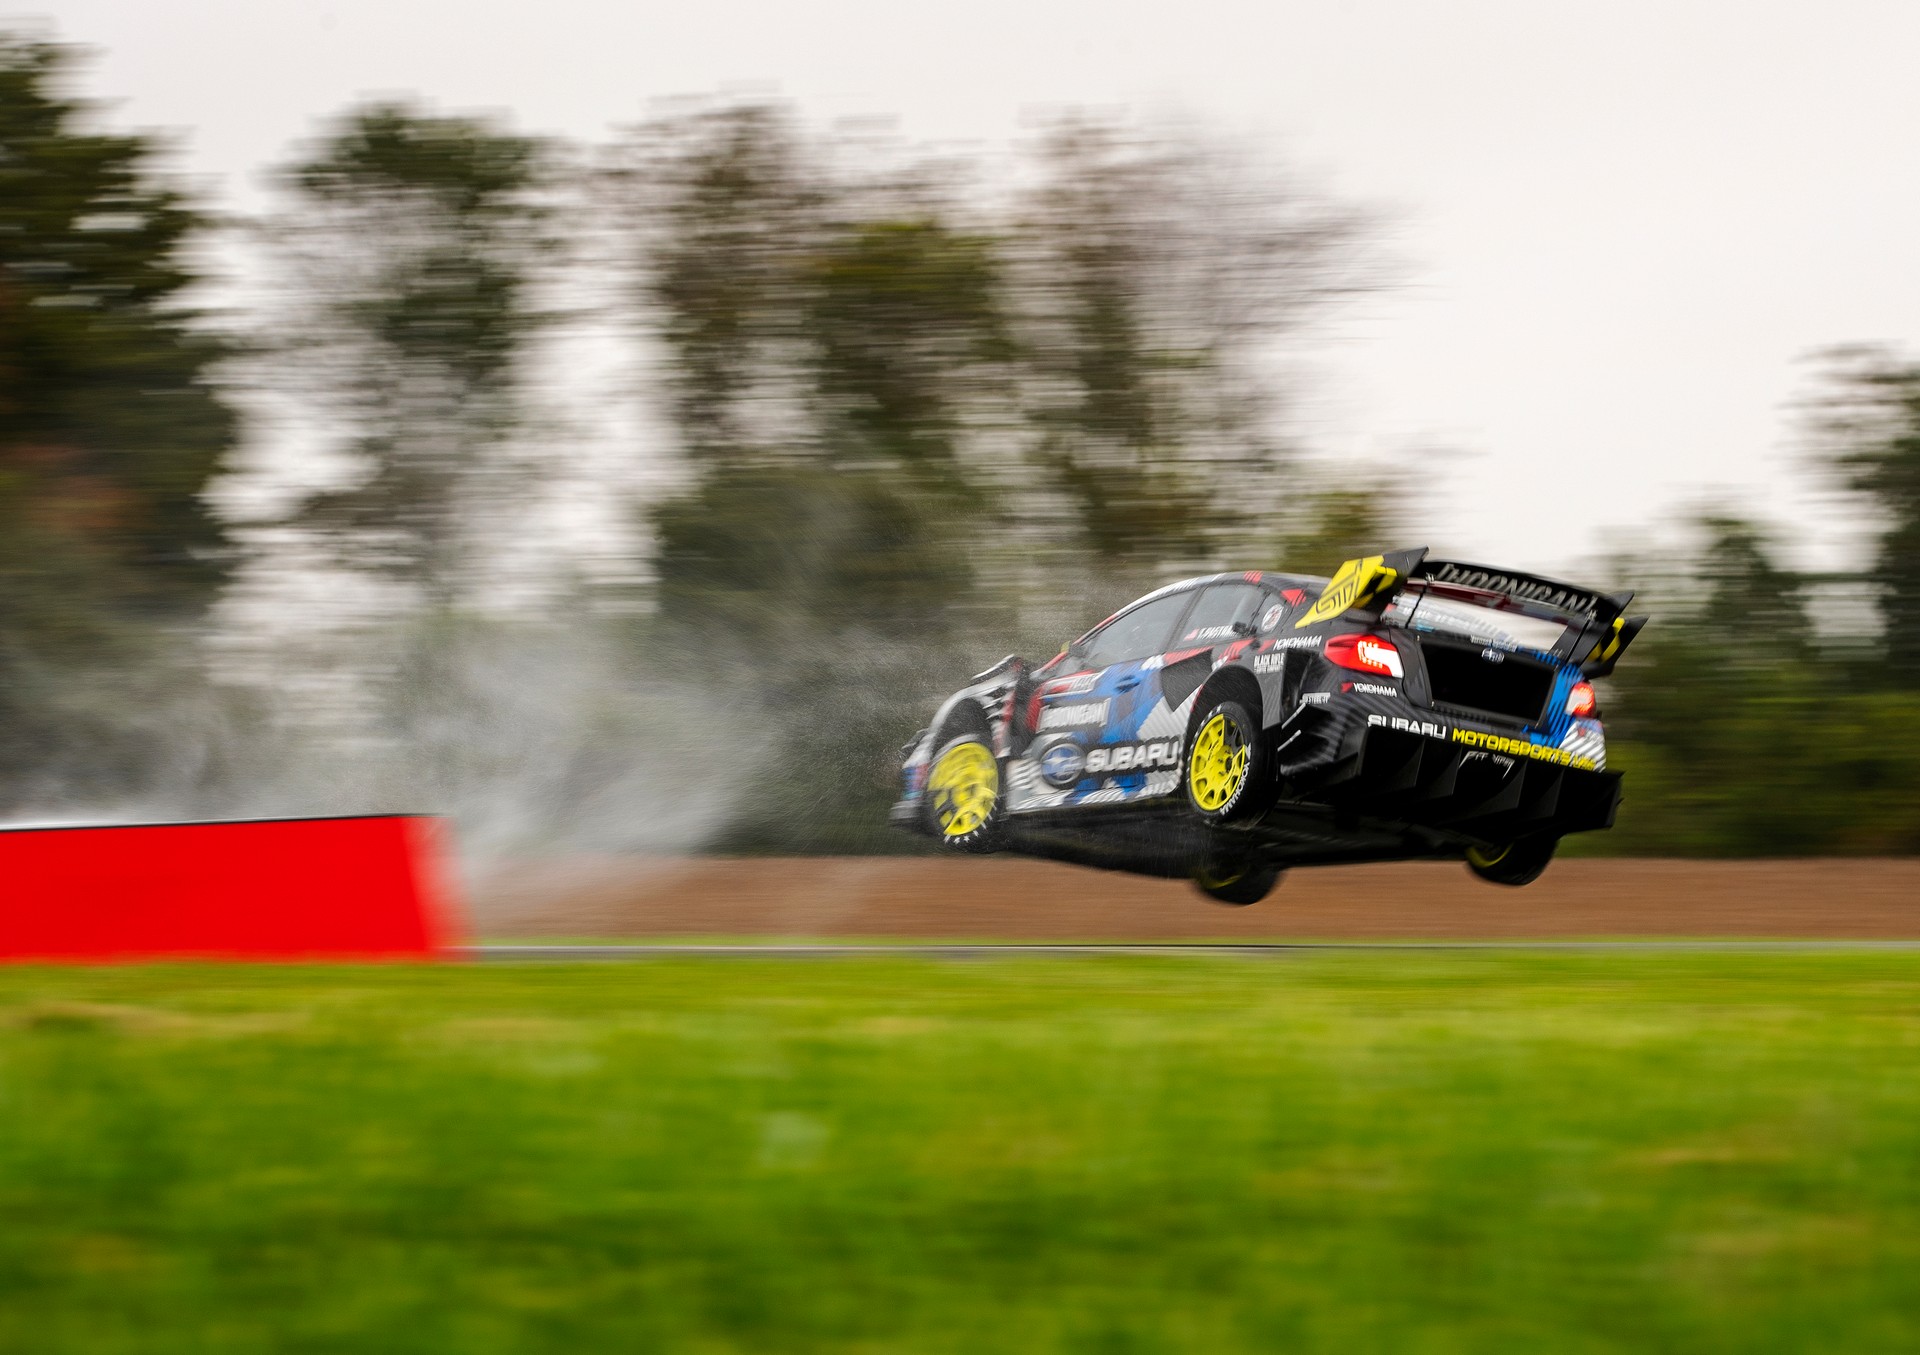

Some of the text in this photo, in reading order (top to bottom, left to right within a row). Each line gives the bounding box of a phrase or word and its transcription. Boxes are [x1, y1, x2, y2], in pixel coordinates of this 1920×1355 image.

[1273, 635, 1322, 651] YOKOHAMA
[1353, 682, 1397, 698] YOKOHAMA
[1084, 740, 1179, 774] SUBARU
[1367, 714, 1447, 740] SUBARU
[1452, 727, 1571, 767] MOTORSPORTS
[1220, 761, 1250, 816] YOKOHAMA
